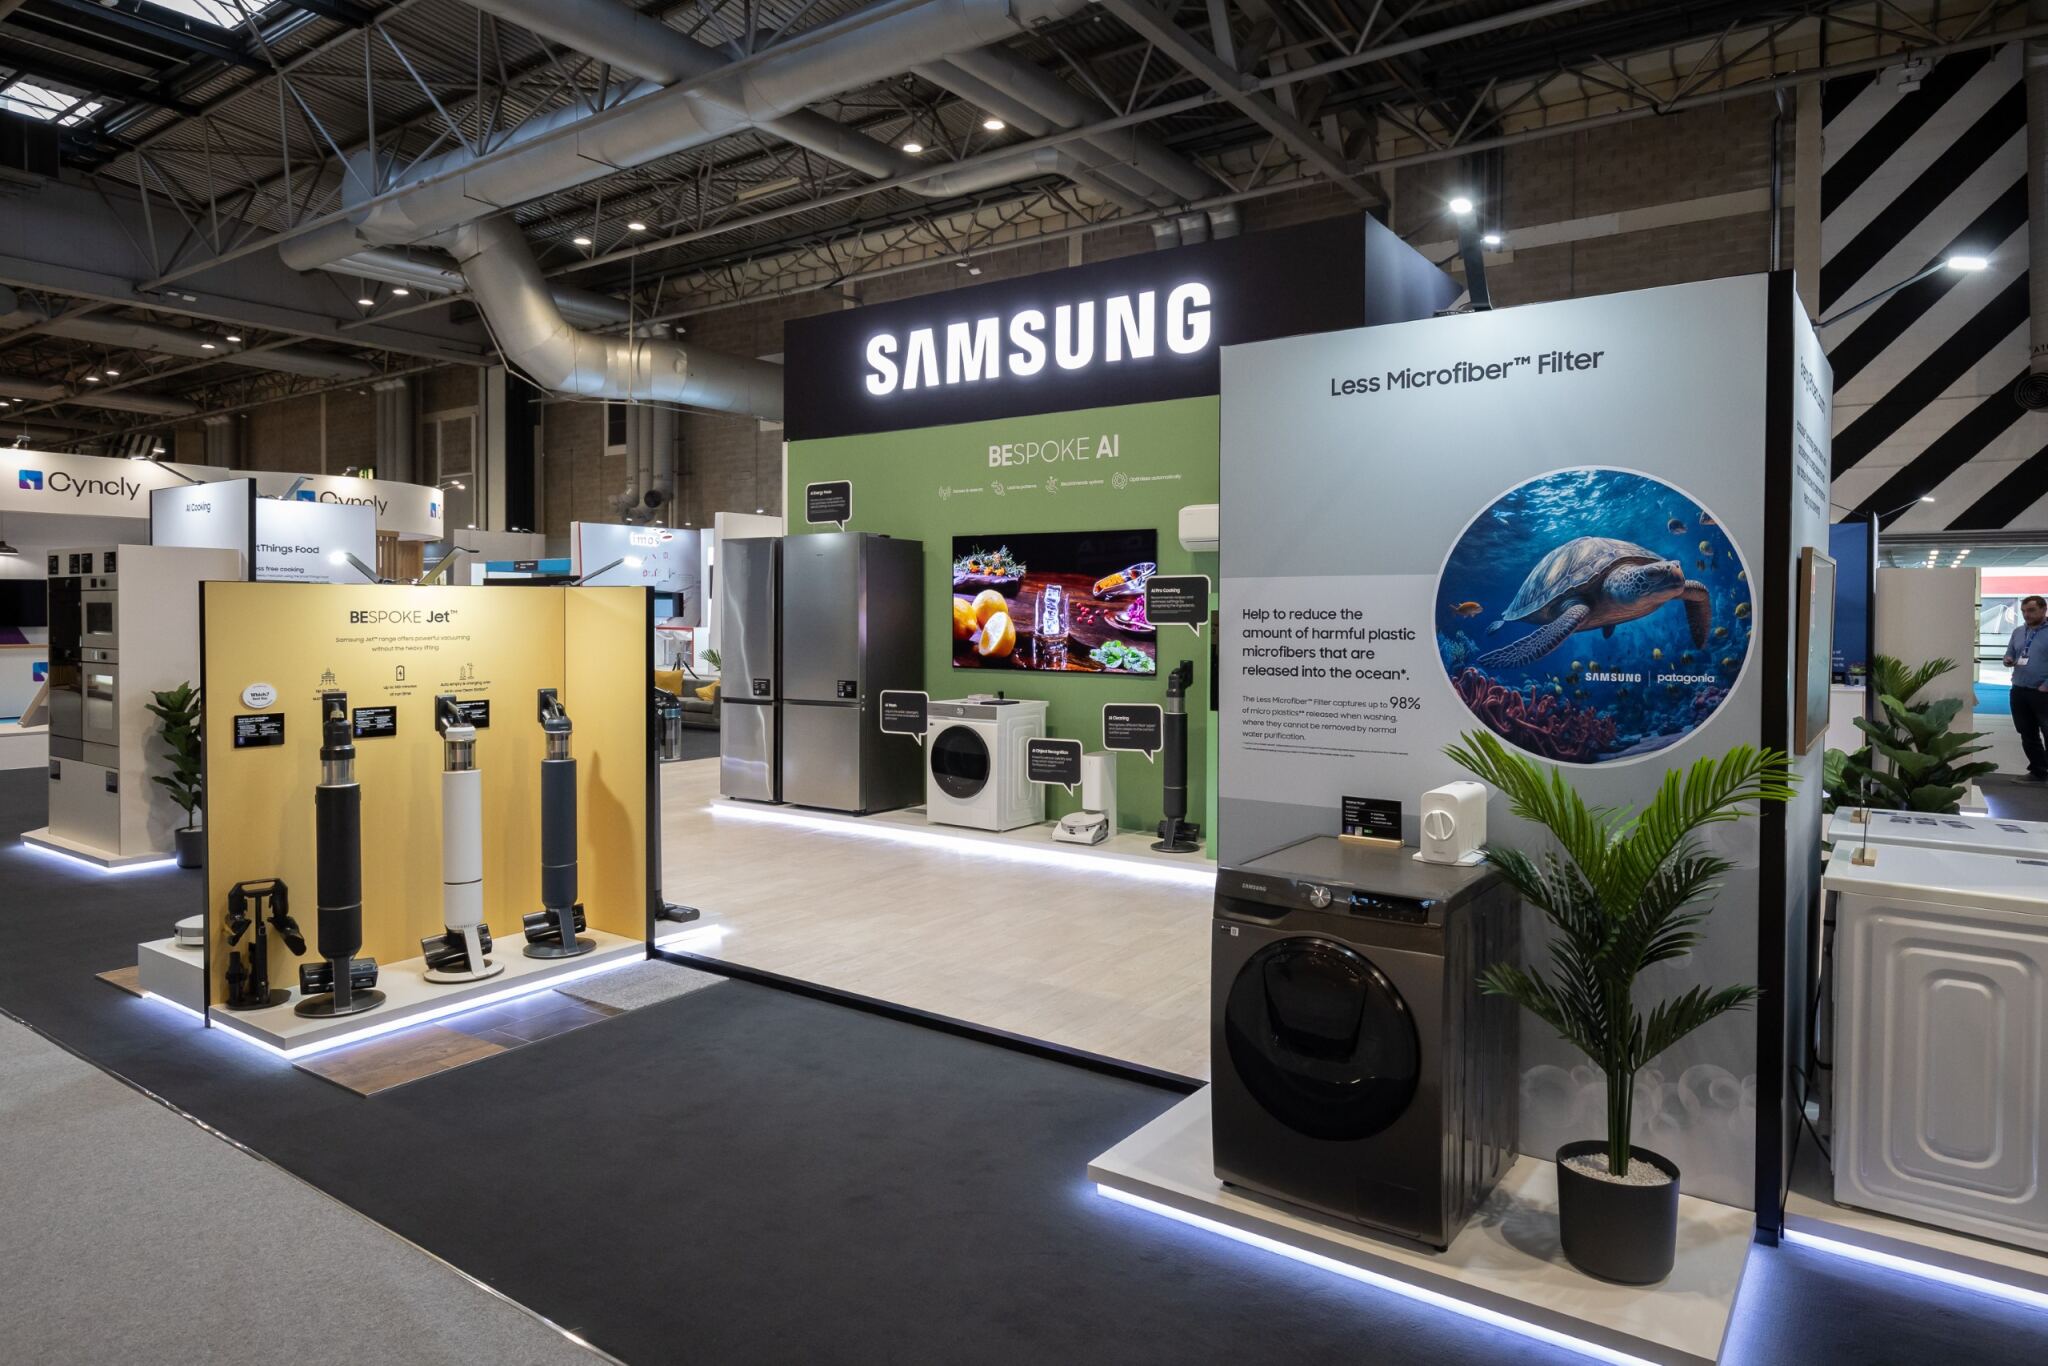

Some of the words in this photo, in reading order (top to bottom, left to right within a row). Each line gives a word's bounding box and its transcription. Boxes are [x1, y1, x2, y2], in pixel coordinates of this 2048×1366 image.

[866, 282, 1212, 396] SAMSUNG
[1331, 376, 1381, 396] Less
[1537, 350, 1605, 374] Filter
[988, 436, 1090, 468] BESPOKE
[1096, 434, 1119, 459] AI
[48, 471, 141, 501] Cyncly
[295, 545, 320, 553] Food
[350, 610, 422, 624] BESPOKE
[1242, 608, 1270, 623] Help
[1273, 609, 1286, 620] to
[1289, 609, 1337, 620] reduce
[1340, 609, 1363, 620] the
[378, 635, 396, 643] range
[415, 634, 439, 642] powerful
[1242, 628, 1292, 639] amount
[1295, 627, 1309, 639] of
[1311, 627, 1365, 640] harmful
[1368, 628, 1416, 643] plastic
[1242, 645, 1316, 658] microfibers
[1320, 646, 1347, 659] that
[1351, 650, 1375, 660] are
[1242, 665, 1299, 677] released
[1301, 666, 1326, 678] into
[1329, 667, 1352, 679] the
[1585, 672, 1642, 683] SAMSUNG
[1657, 673, 1715, 684] patagonia
[1242, 695, 1255, 703] The
[1313, 698, 1331, 706] Filter
[1332, 699, 1367, 709] captures
[1368, 700, 1379, 709] up
[1389, 696, 1421, 710] 98%
[1250, 707, 1271, 715] micro
[1305, 711, 1339, 719] released
[1266, 719, 1282, 729] they
[1283, 720, 1310, 730] cannot
[1310, 722, 1321, 730] be
[1321, 724, 1356, 732] removed
[1356, 725, 1367, 734] by
[1368, 726, 1397, 734] normal
[1242, 731, 1263, 739] water
[1264, 731, 1306, 741] purification.
